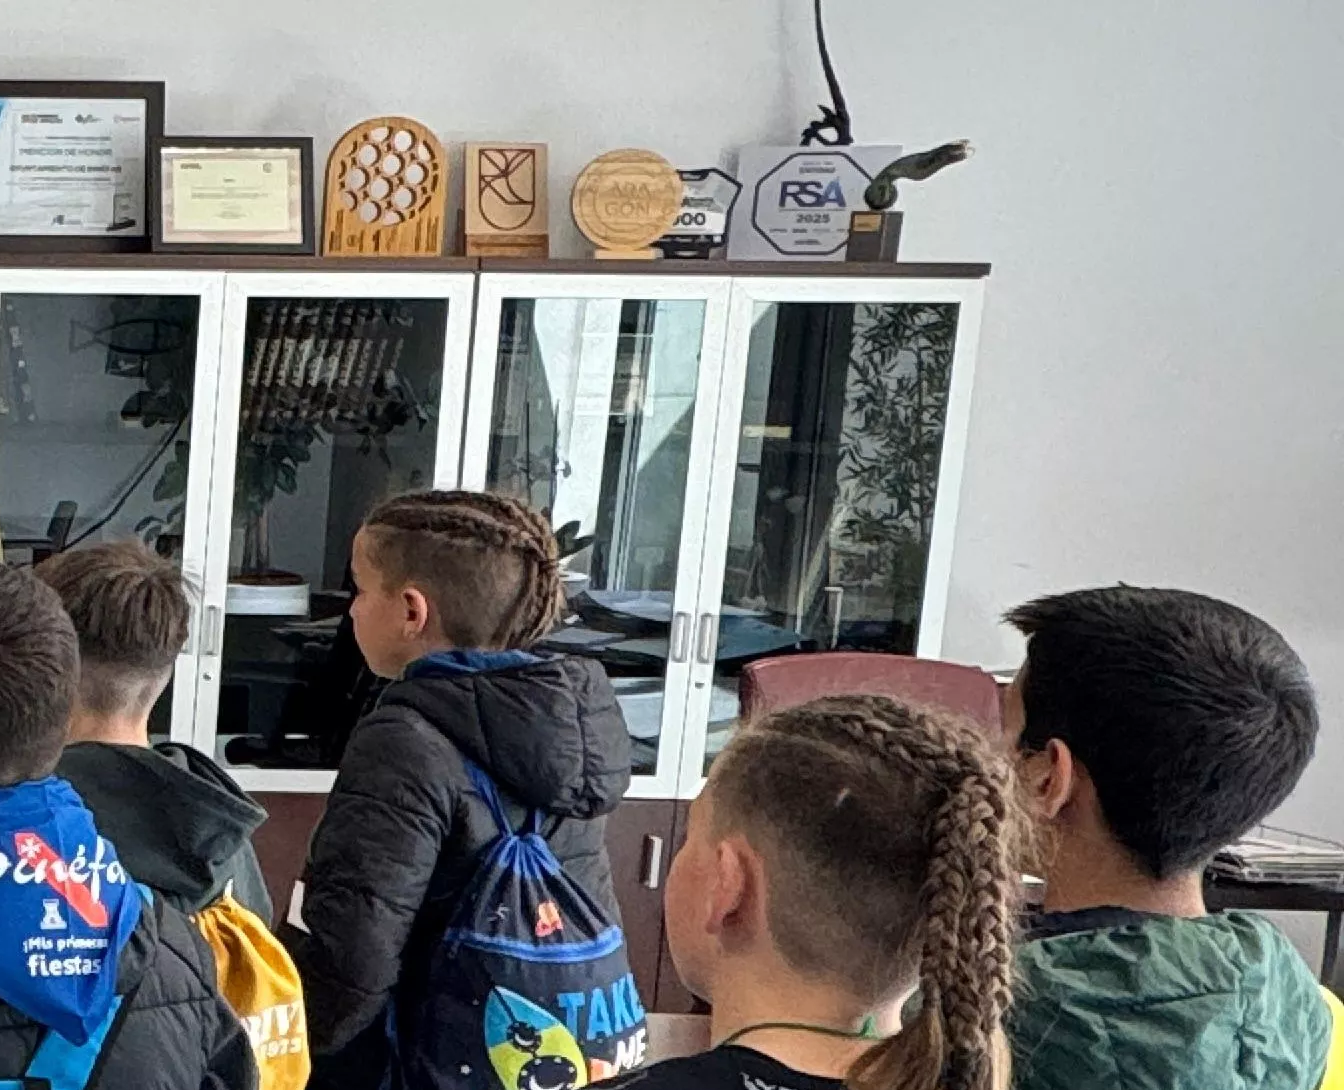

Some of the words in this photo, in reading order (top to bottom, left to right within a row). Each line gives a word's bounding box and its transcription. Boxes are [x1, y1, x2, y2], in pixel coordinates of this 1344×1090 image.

[779, 177, 846, 207] RSA
[796, 213, 831, 223] 2025
[616, 1028, 646, 1070] ME
